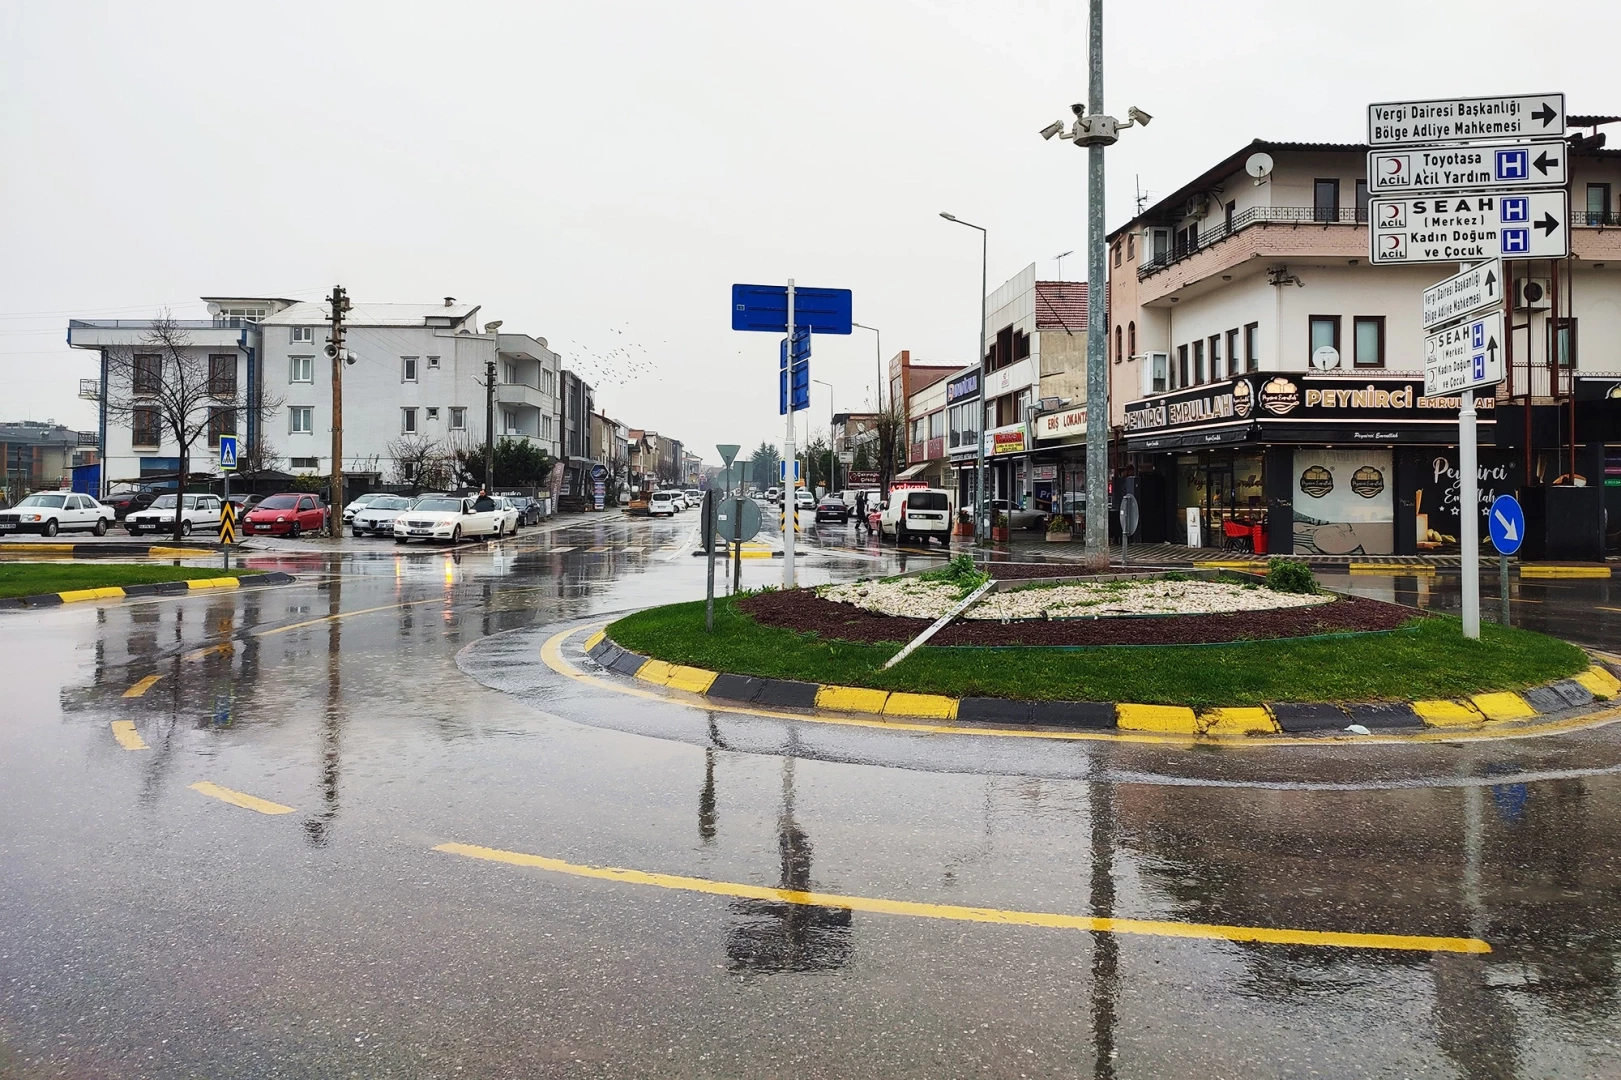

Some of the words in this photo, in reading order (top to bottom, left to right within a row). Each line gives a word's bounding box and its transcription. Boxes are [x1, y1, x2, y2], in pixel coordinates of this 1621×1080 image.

[1375, 106, 1406, 122] Vergi
[1411, 105, 1453, 119] Dairesi
[1458, 100, 1520, 117] Başkanlığı
[1375, 125, 1408, 141] Bölge
[1412, 123, 1450, 139] Adliye
[1454, 119, 1521, 135] Mahkemesi
[1423, 152, 1482, 168] Toyotasa
[1502, 153, 1522, 176] H
[1380, 175, 1408, 185] ACİL
[1443, 170, 1491, 184] Yardım
[1412, 198, 1494, 214] SEAH
[1381, 219, 1405, 228] ACİL
[1410, 231, 1447, 243] Kadın
[1453, 229, 1497, 243] Doğum
[1381, 249, 1405, 258] ACİL
[1425, 248, 1439, 257] ve
[1445, 245, 1483, 258] Çocuk
[1438, 325, 1470, 348] SEAH
[1305, 385, 1413, 408] PEYNİRCİ
[1417, 397, 1495, 408] EMRULAH
[1123, 400, 1167, 431] PEYNİRCİ
[1168, 393, 1234, 425] EMRULLAH
[1432, 457, 1508, 489] Peyirci
